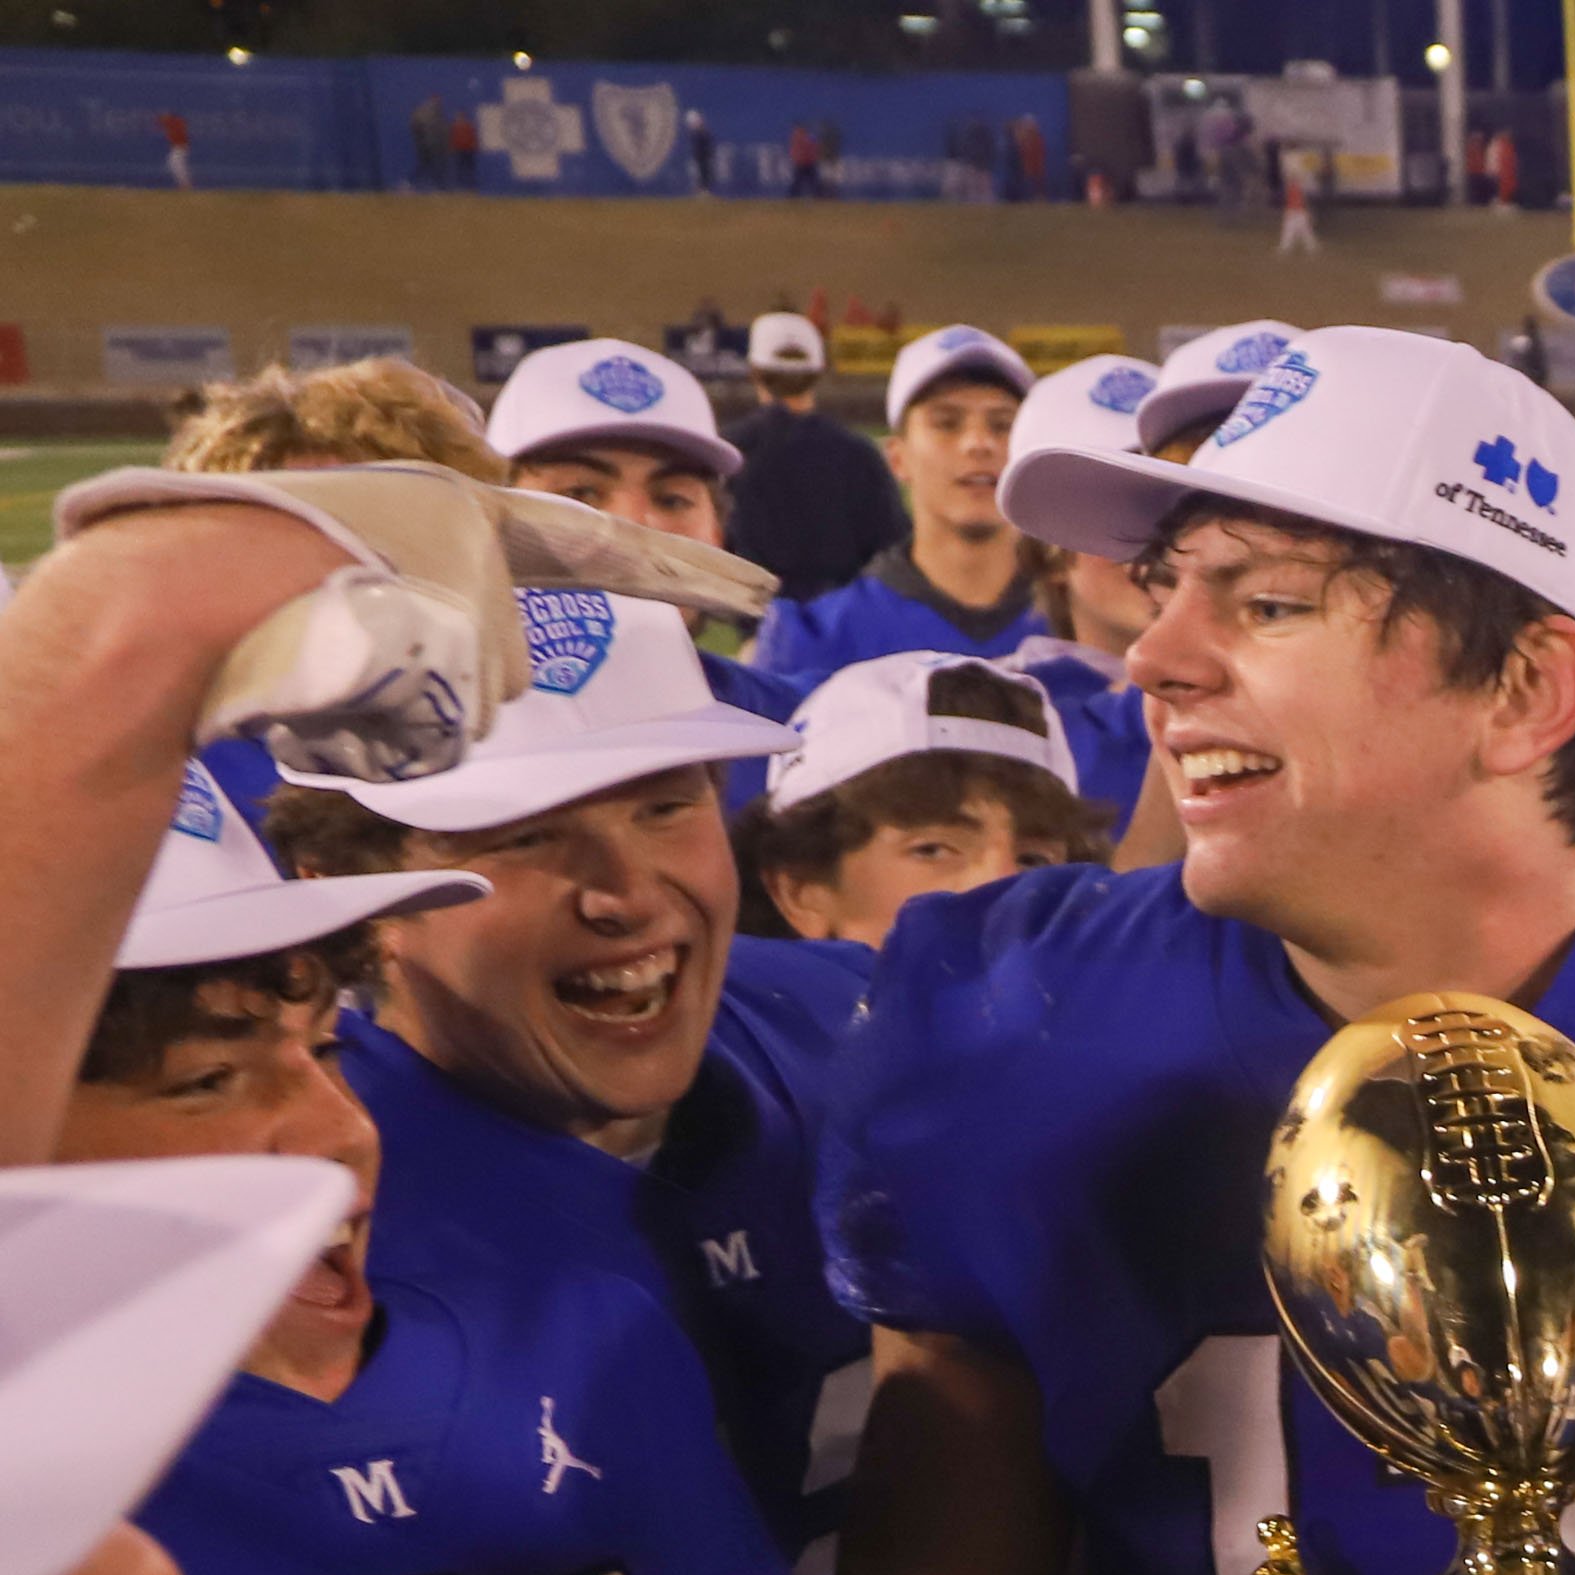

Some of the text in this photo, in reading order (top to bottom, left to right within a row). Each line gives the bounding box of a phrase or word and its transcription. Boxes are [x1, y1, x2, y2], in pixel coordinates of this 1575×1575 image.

[1435, 482, 1569, 557] of Tennessee
[699, 1229, 760, 1287] M
[330, 1459, 417, 1524] M
